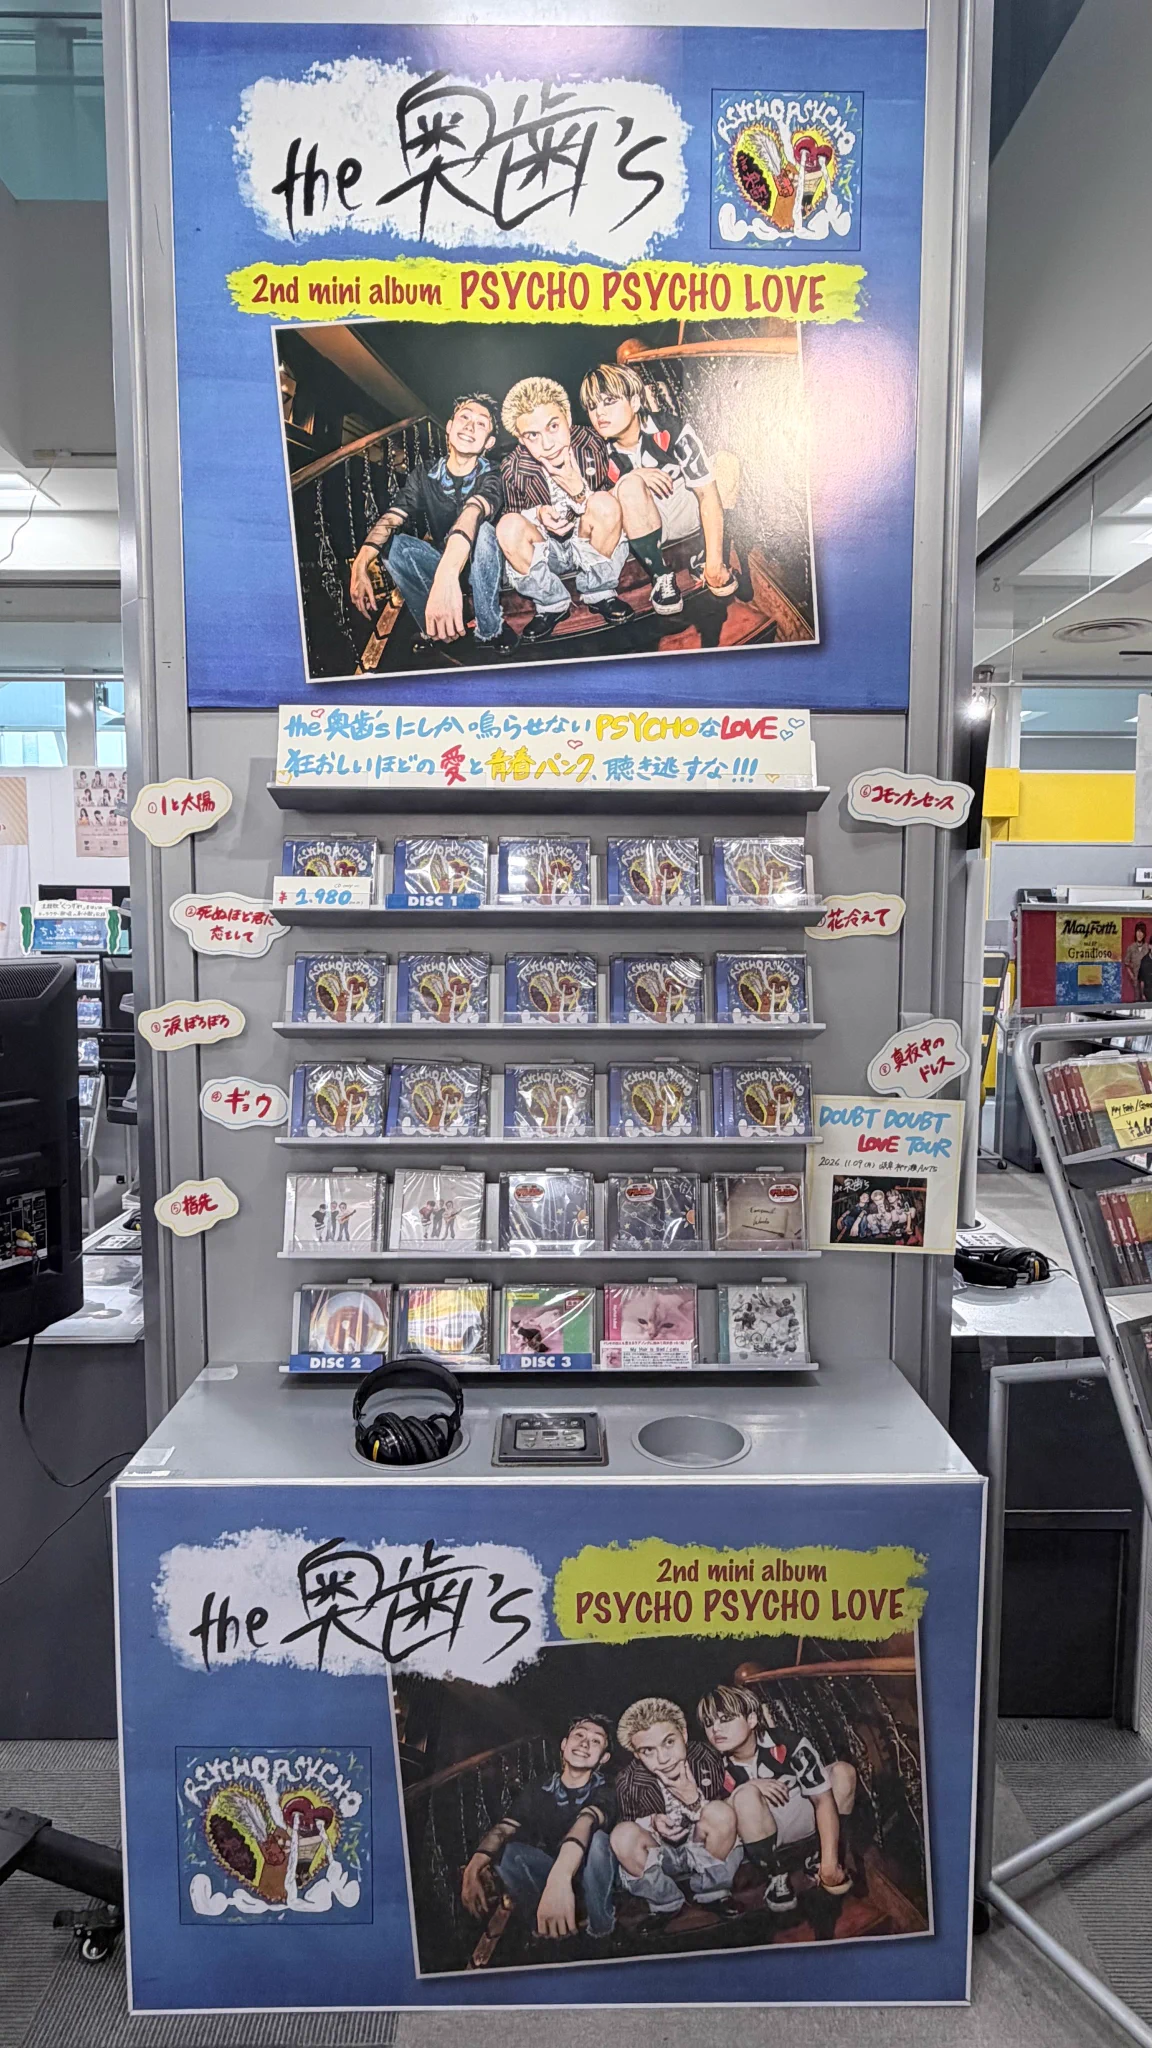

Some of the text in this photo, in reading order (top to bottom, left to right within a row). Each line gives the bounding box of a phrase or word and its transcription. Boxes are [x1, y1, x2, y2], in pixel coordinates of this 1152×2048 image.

[272, 138, 362, 242] the
[253, 271, 825, 313] 2nd mini album PSYCHO PSYCHO LOVE
[408, 895, 458, 906] DISC 1
[819, 1105, 951, 1132] DOUBT DOUBT
[857, 1134, 952, 1158] LOVE TOUR
[818, 1156, 840, 1167] 2026
[310, 1357, 361, 1368] DISC 2
[520, 1356, 572, 1368] DISC 3
[657, 1557, 827, 1584] 2nd mini album
[577, 1587, 904, 1624] PSYCHO PSYCHO LOVE
[190, 1592, 269, 1672] the
